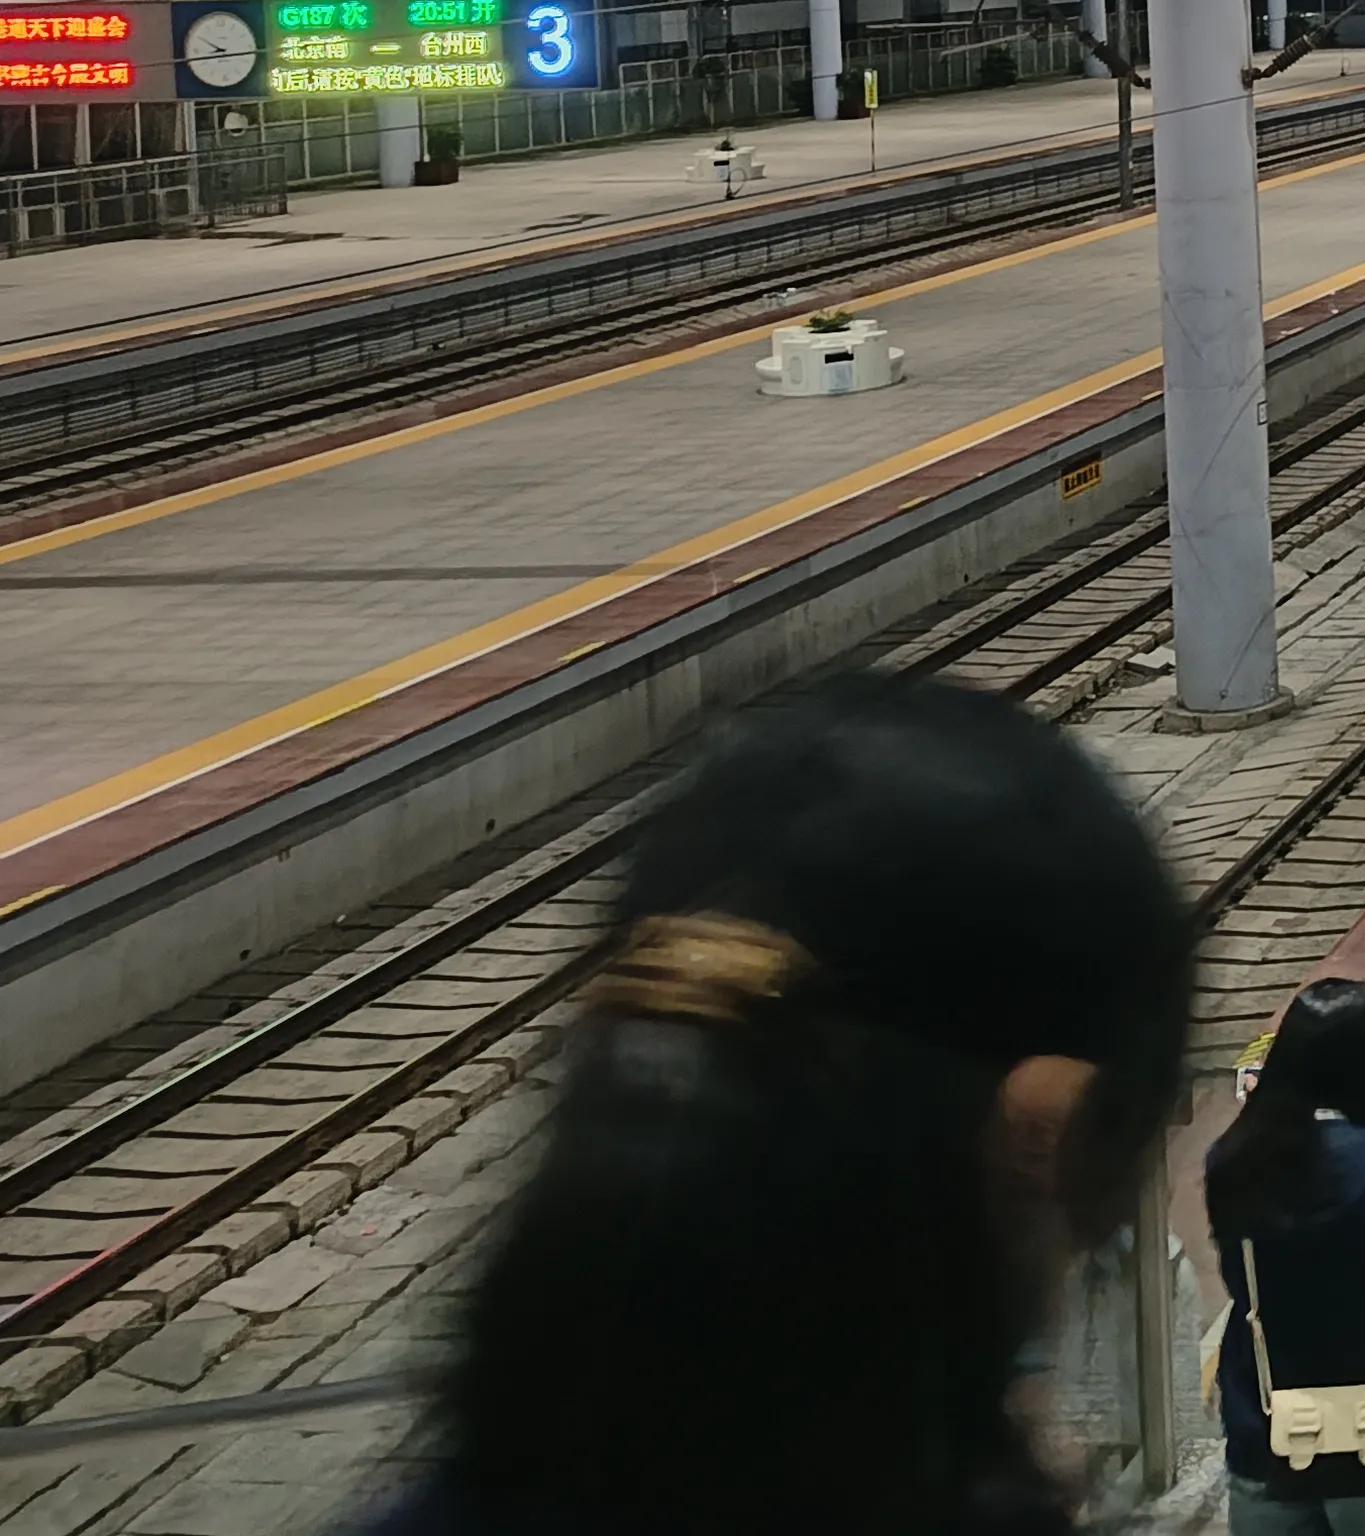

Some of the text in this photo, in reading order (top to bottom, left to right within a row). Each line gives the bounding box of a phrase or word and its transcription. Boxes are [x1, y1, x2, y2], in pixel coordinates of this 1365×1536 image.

[280, 5, 336, 27] G187
[341, 2, 368, 27] 次
[409, 1, 466, 23] 20:51
[282, 35, 348, 60] 北京南
[420, 31, 487, 59] 台州西
[527, 5, 572, 74] 3
